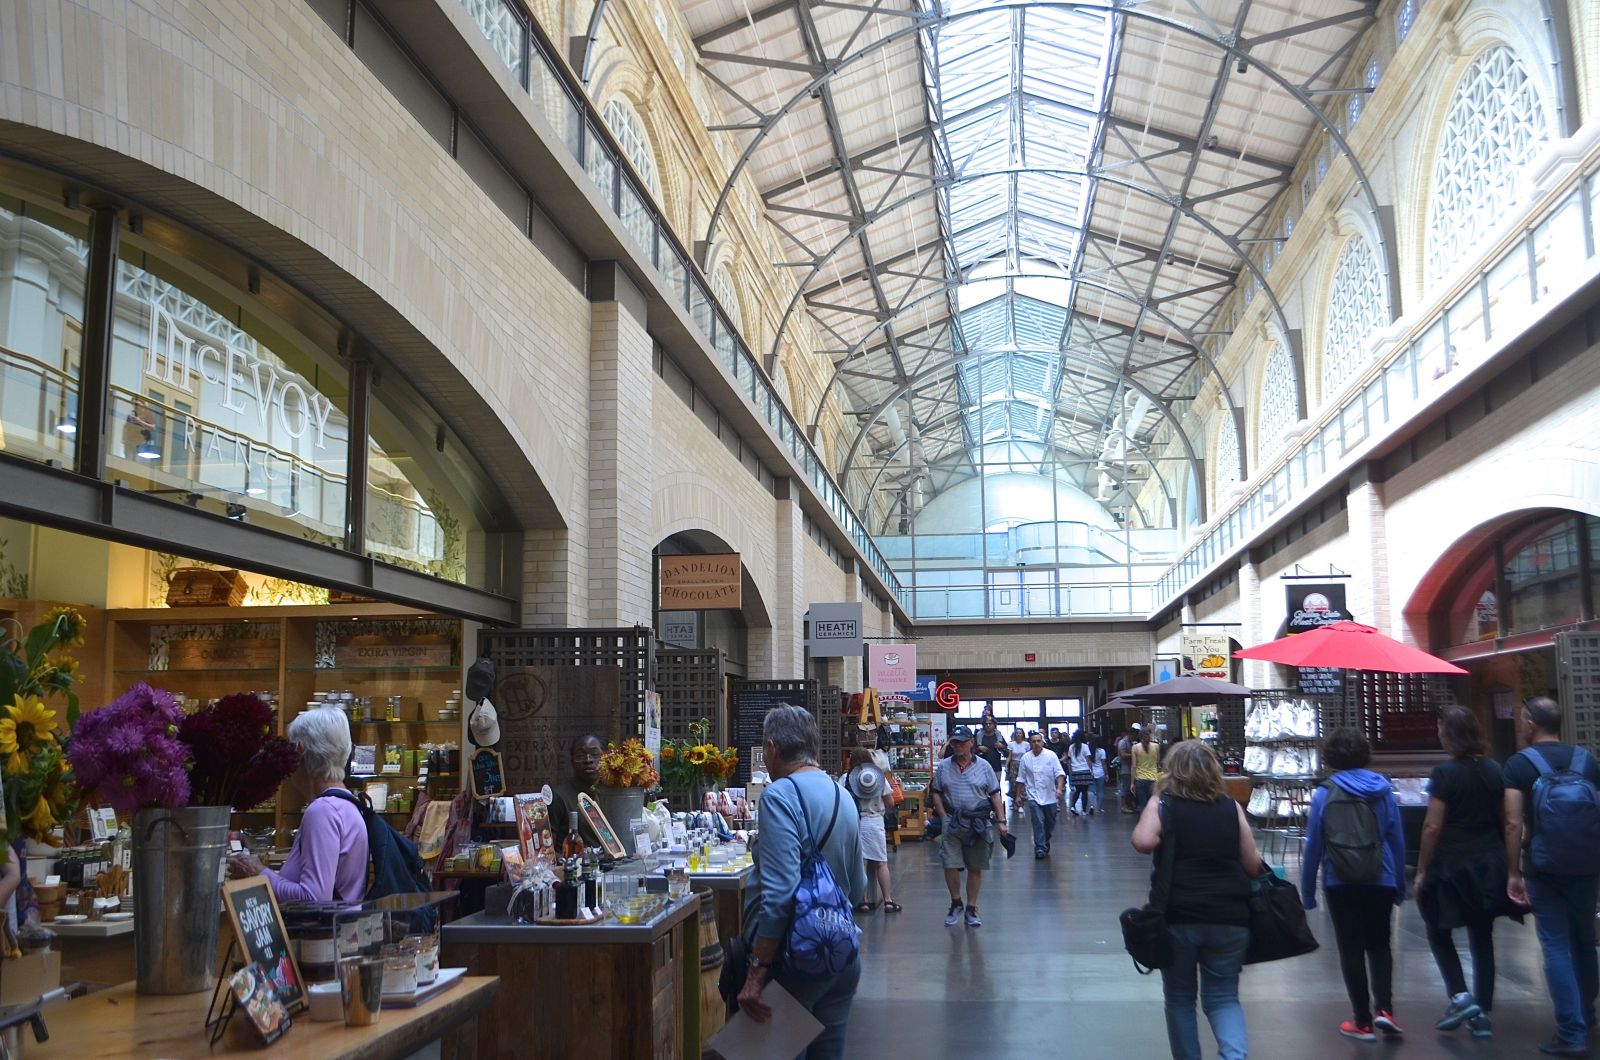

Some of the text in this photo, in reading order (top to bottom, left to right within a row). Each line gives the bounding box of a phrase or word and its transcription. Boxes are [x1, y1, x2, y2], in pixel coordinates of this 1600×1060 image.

[184, 416, 302, 488] RANCH
[664, 563, 737, 579] DANDELION
[664, 584, 737, 601] CHOCOLATE
[818, 623, 854, 631] HEATH
[1183, 636, 1226, 645] Farm Fresh
[358, 647, 427, 657] EXTRA VIRGIN
[1190, 645, 1220, 653] To You
[936, 682, 960, 709] G
[507, 755, 568, 771] OLIVE
[245, 896, 258, 908] NEW
[239, 902, 274, 933] SAVORY
[255, 926, 273, 949] JAM
